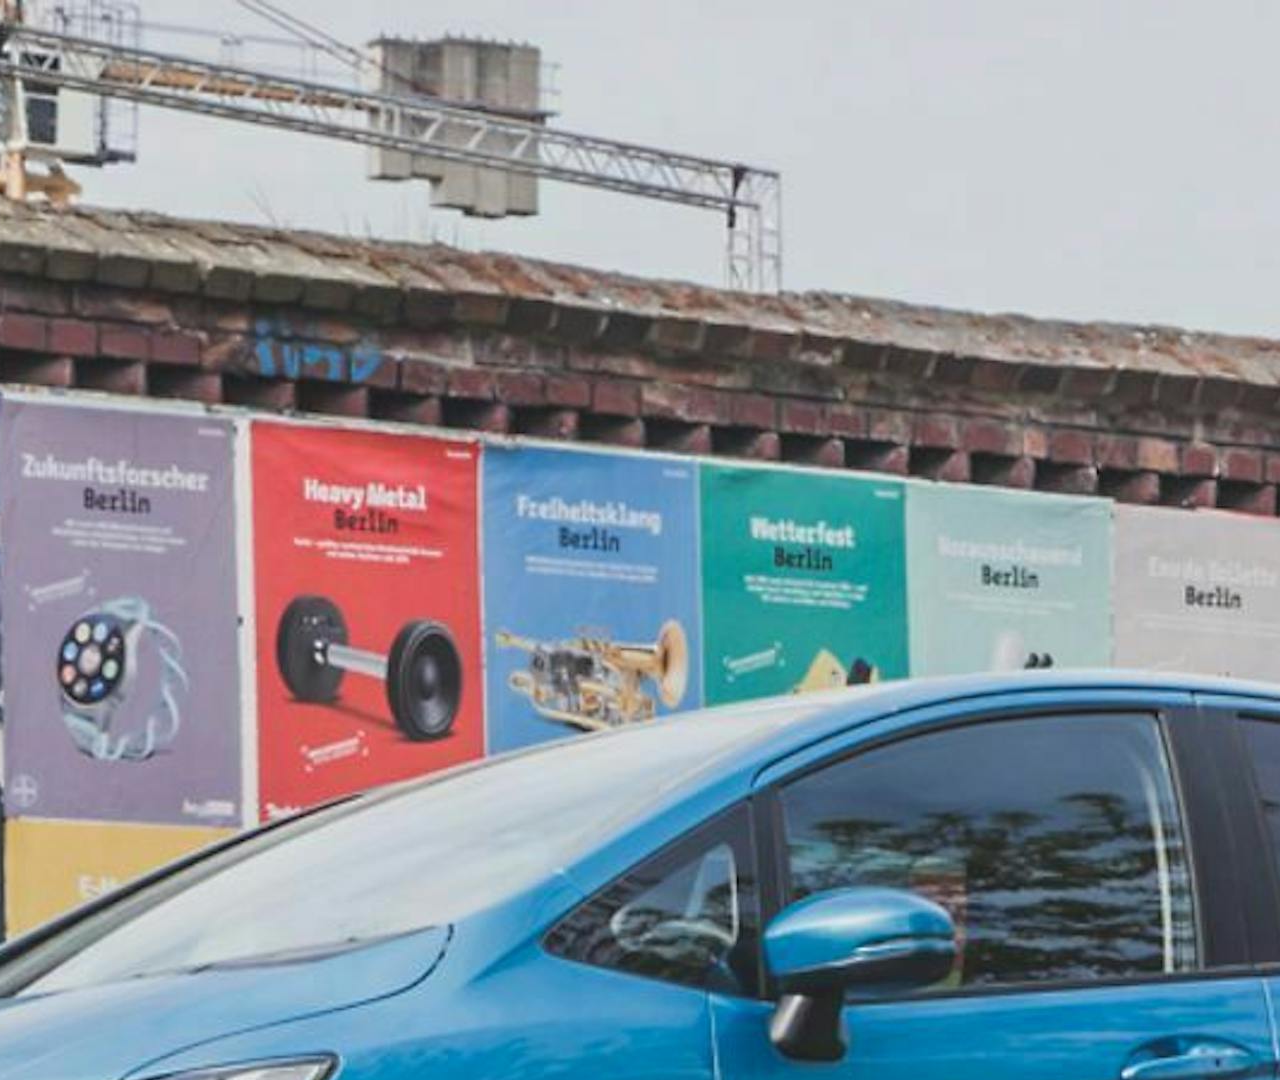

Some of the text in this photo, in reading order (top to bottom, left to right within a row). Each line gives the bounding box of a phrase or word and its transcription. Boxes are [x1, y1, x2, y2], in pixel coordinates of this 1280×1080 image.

[22, 453, 210, 492] Zukunftsforscher
[82, 487, 152, 515] Berlin
[305, 479, 427, 511] Heavy Metal
[334, 508, 398, 534] Berlin
[517, 495, 662, 535] Freiheitsklang
[558, 526, 621, 553] Berlin
[750, 517, 857, 548] Wetterfest
[774, 546, 833, 572] Berlin
[980, 564, 1039, 589] Berlin
[1184, 585, 1243, 609] Berlin
